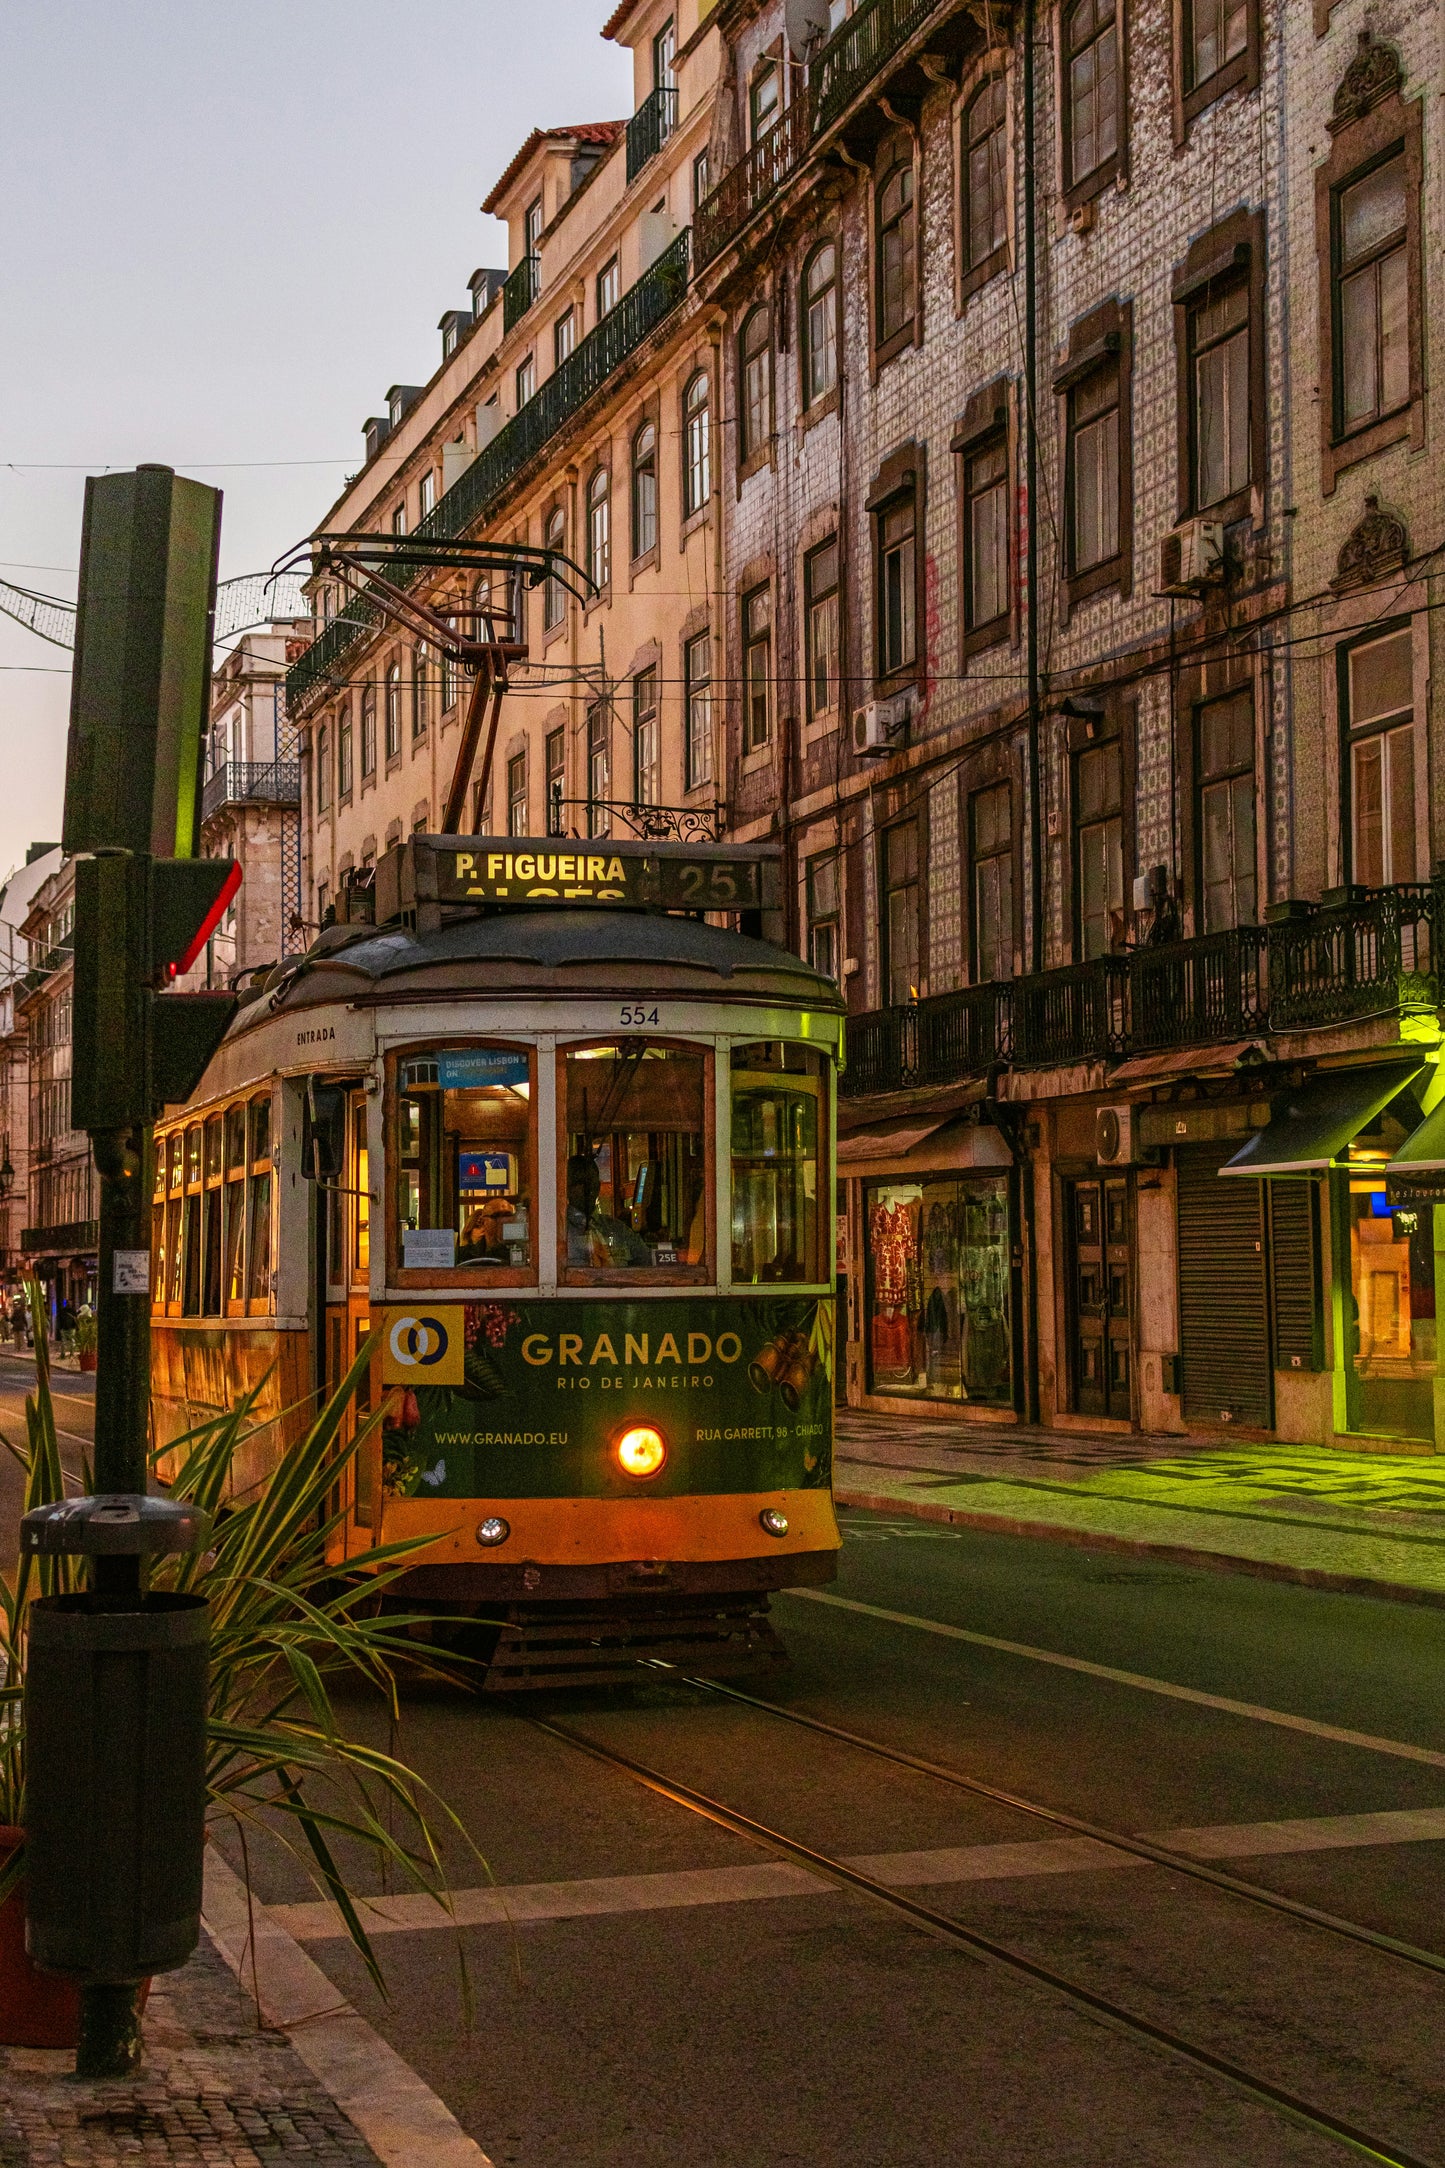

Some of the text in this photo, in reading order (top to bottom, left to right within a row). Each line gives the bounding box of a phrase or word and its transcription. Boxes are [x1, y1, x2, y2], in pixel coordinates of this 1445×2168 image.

[456, 853, 627, 882] P. FIGUEIRA
[620, 1006, 660, 1026] 554
[297, 1027, 336, 1046] ENTRADA
[446, 1056, 519, 1069] DISCOVER LISBON
[658, 1253, 678, 1263] 25E
[521, 1331, 743, 1366] GRANADO
[557, 1375, 714, 1389] RIO DE JANEIRO
[434, 1432, 568, 1445] WWW.GRANADO.EU
[696, 1428, 721, 1441] RUA
[723, 1426, 775, 1440] GARRETT,
[776, 1426, 788, 1438] 98
[795, 1423, 823, 1437] CHIADO
